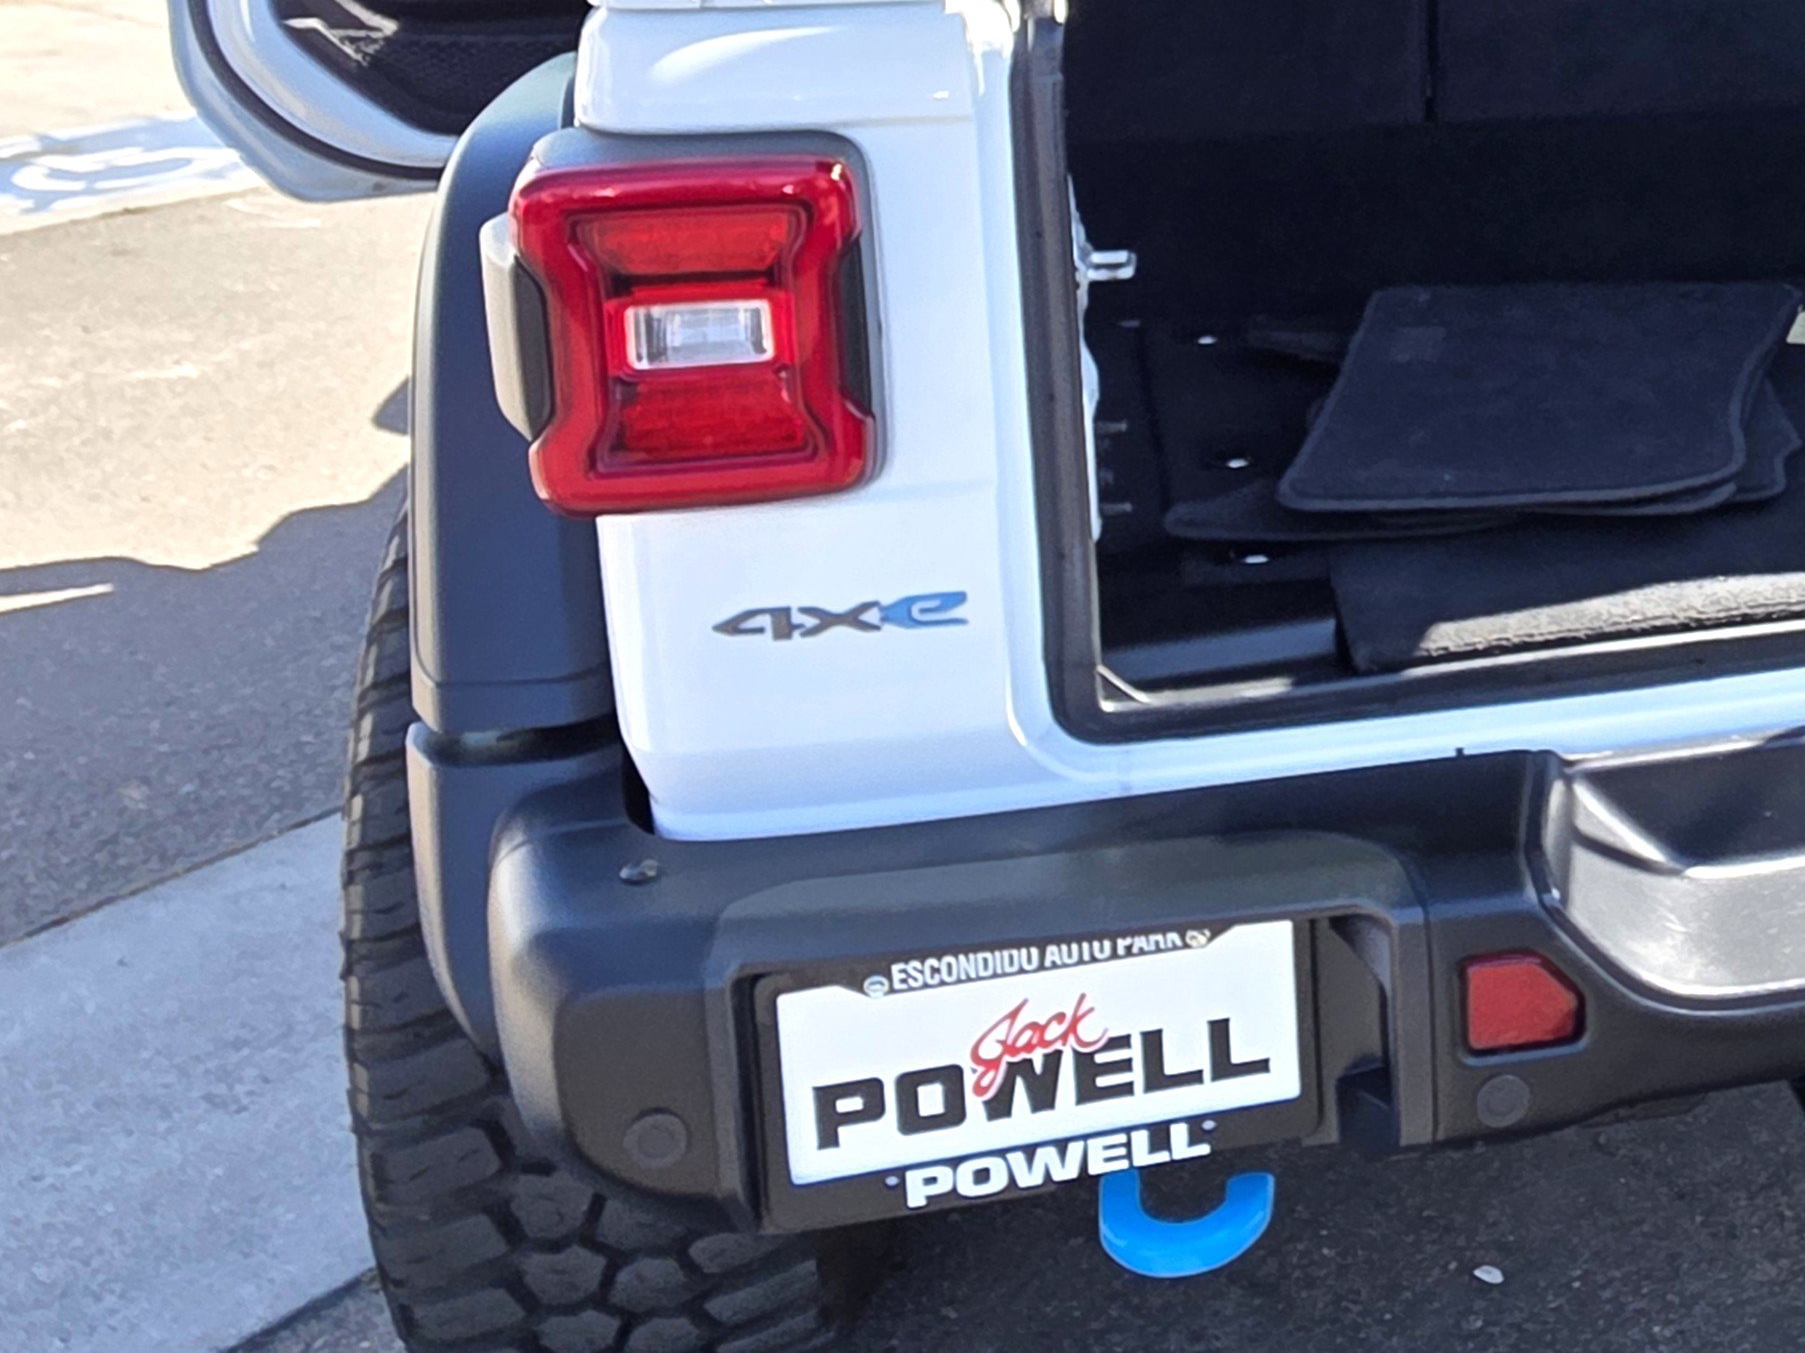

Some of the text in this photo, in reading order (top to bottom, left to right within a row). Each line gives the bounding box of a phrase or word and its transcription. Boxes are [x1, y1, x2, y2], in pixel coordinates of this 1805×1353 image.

[890, 946, 1040, 992] ESCONDIDO
[1043, 939, 1112, 969] AUTO
[812, 1017, 1271, 1151] POWELL
[970, 992, 1108, 1098] Jack
[904, 1121, 1212, 1209] POWELL
